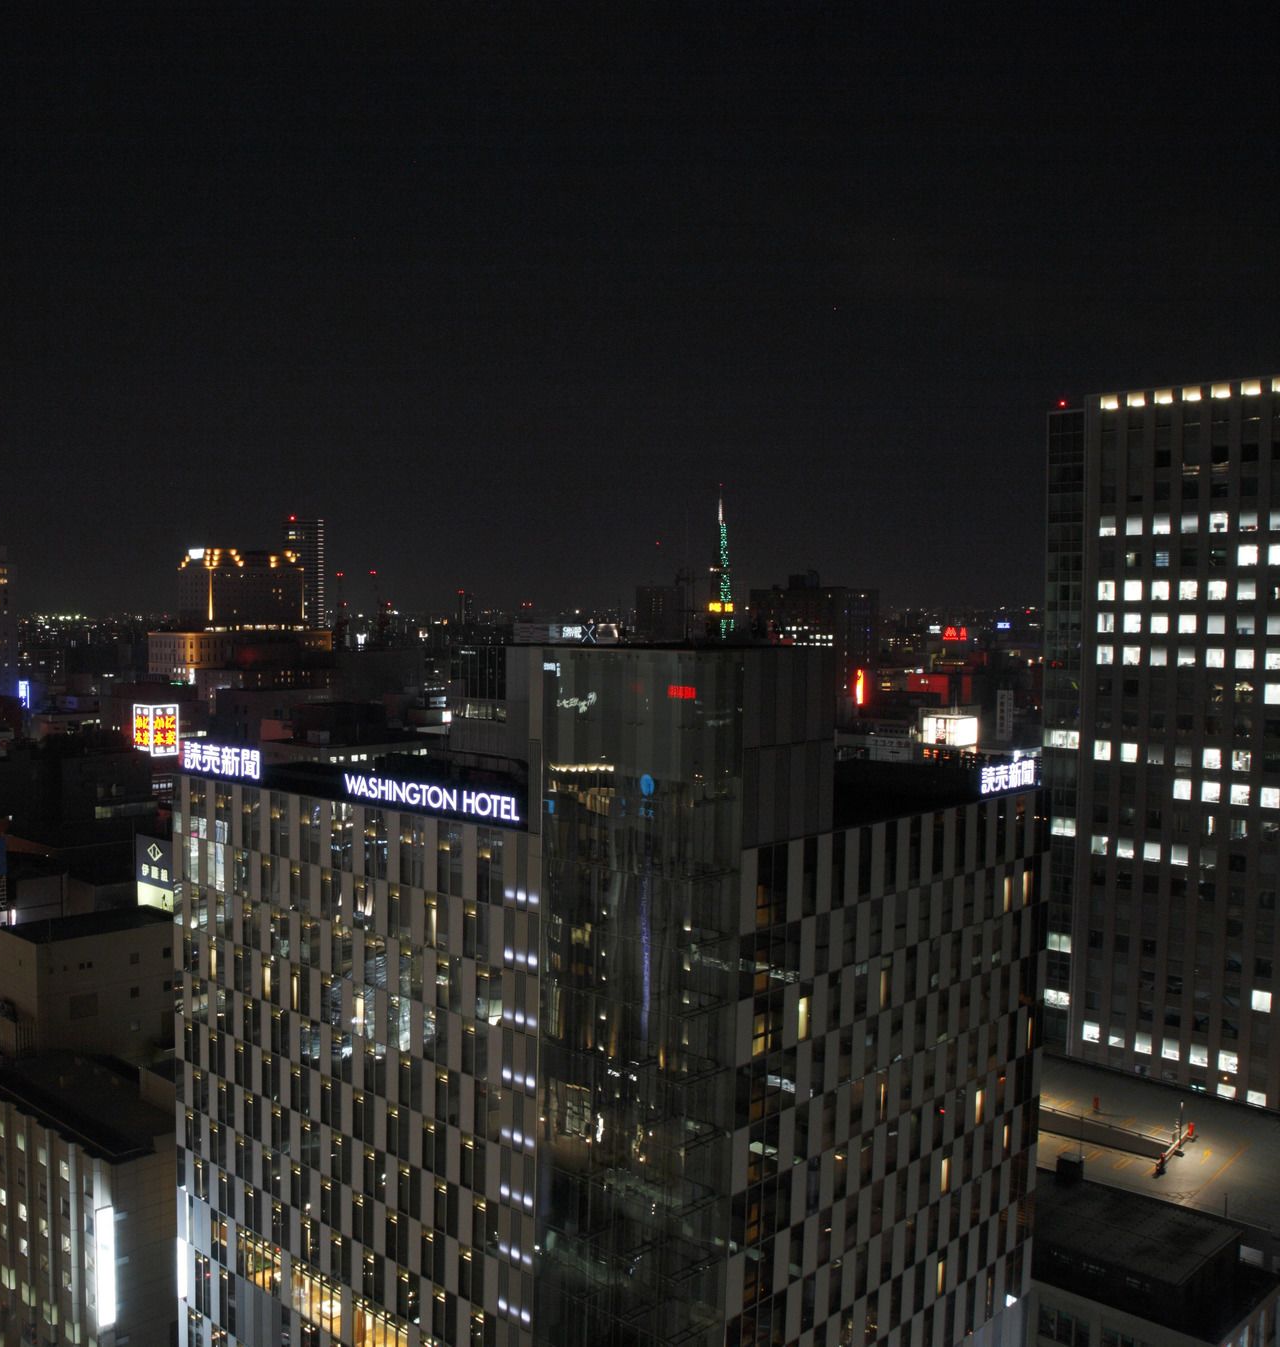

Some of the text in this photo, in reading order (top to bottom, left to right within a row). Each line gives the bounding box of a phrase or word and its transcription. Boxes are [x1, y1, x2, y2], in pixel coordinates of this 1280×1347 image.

[153, 715, 176, 730] かに
[153, 730, 177, 746] 本家
[184, 742, 260, 779] 読売新聞
[980, 759, 1036, 795] 読売新聞
[344, 774, 520, 821] WASHINGTON HOTEL
